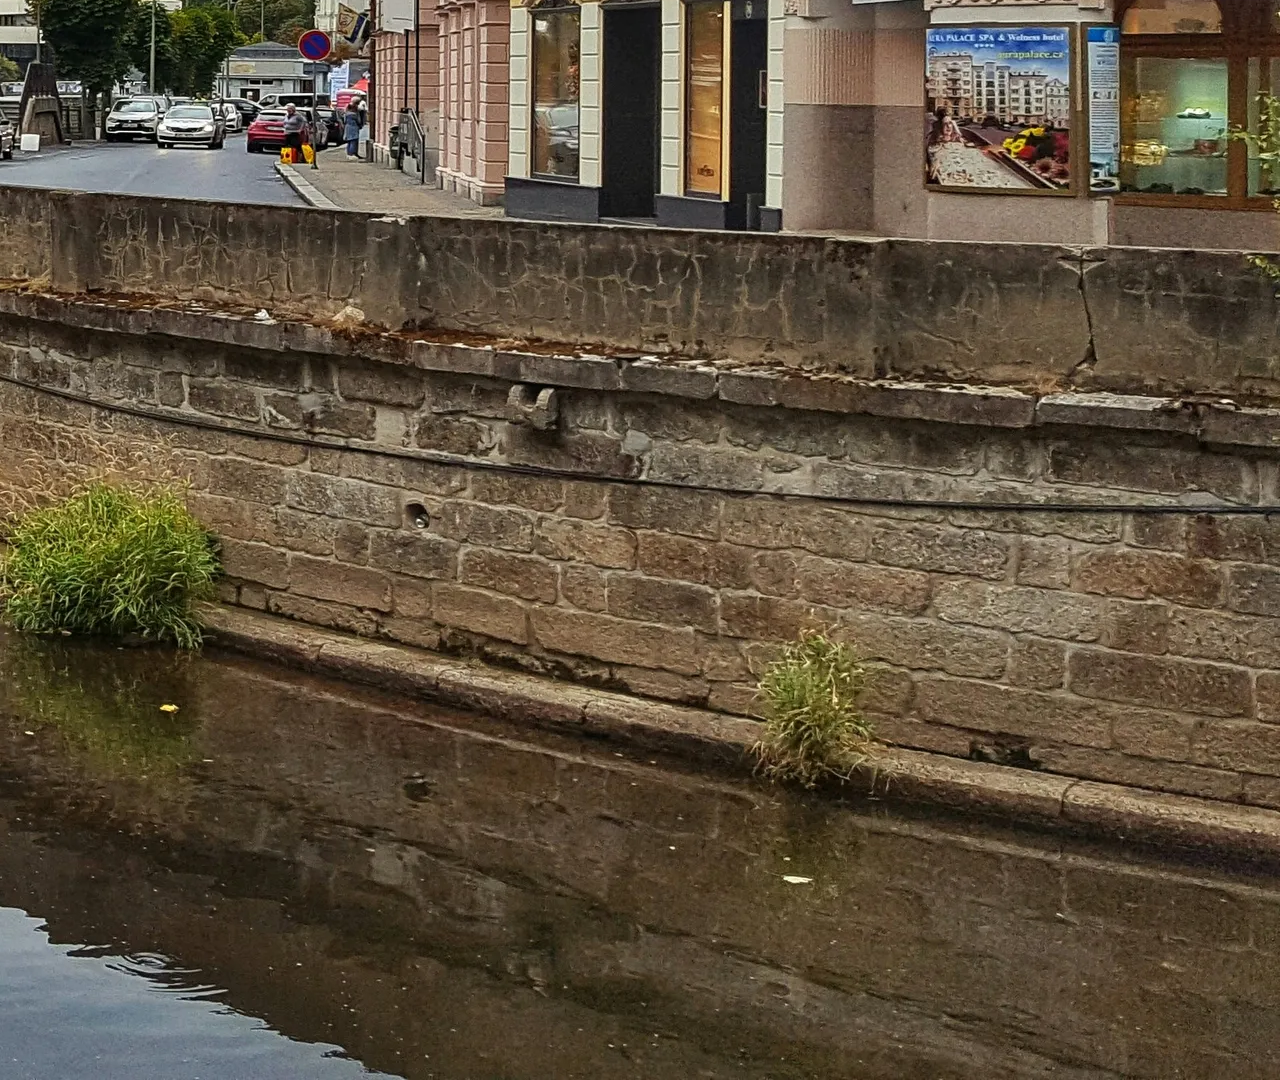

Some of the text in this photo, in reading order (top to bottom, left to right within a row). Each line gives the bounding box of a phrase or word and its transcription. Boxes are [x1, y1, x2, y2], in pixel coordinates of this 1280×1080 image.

[946, 33, 976, 41] PALACE
[978, 33, 995, 41] SPA
[998, 33, 1006, 41] &
[1042, 33, 1064, 41] hotel
